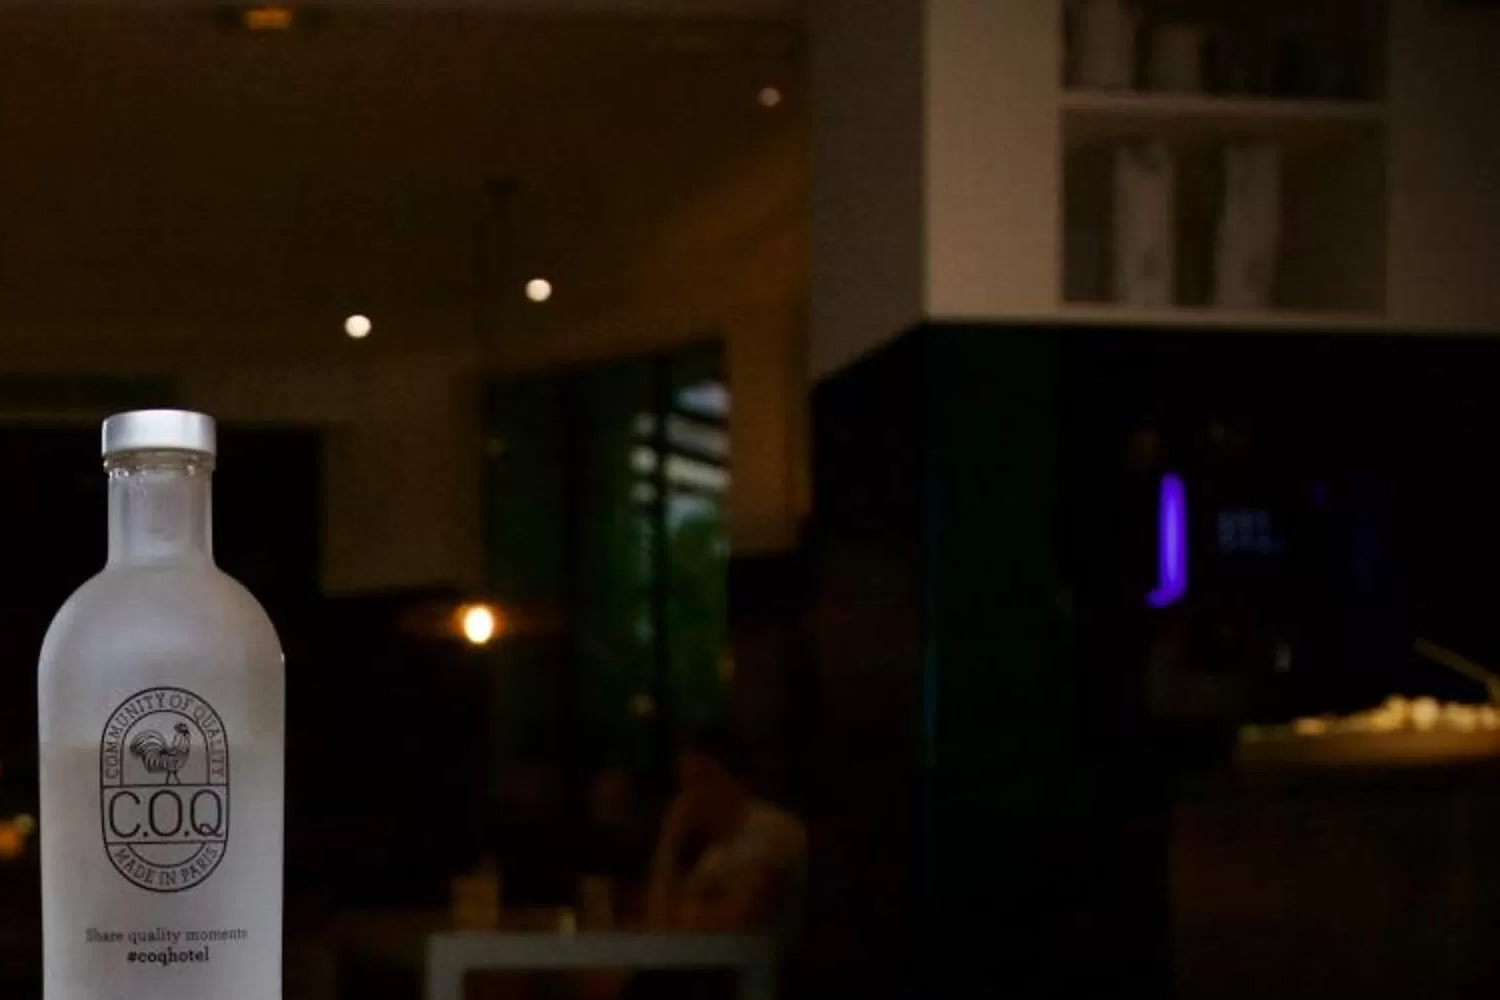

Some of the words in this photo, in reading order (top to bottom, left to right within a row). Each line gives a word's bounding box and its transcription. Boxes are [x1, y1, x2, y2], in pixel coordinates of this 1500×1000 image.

[104, 692, 165, 779] COMMUNITY
[169, 693, 192, 711] OF
[192, 704, 225, 778] QUALITY
[108, 789, 224, 839] C.O.Q
[114, 847, 153, 884] MADE
[158, 870, 178, 885] IN
[181, 845, 219, 883] PARIS
[85, 927, 124, 943] Share
[128, 927, 181, 945] quality
[185, 928, 248, 941] moments
[126, 946, 210, 966] #coqhotel
